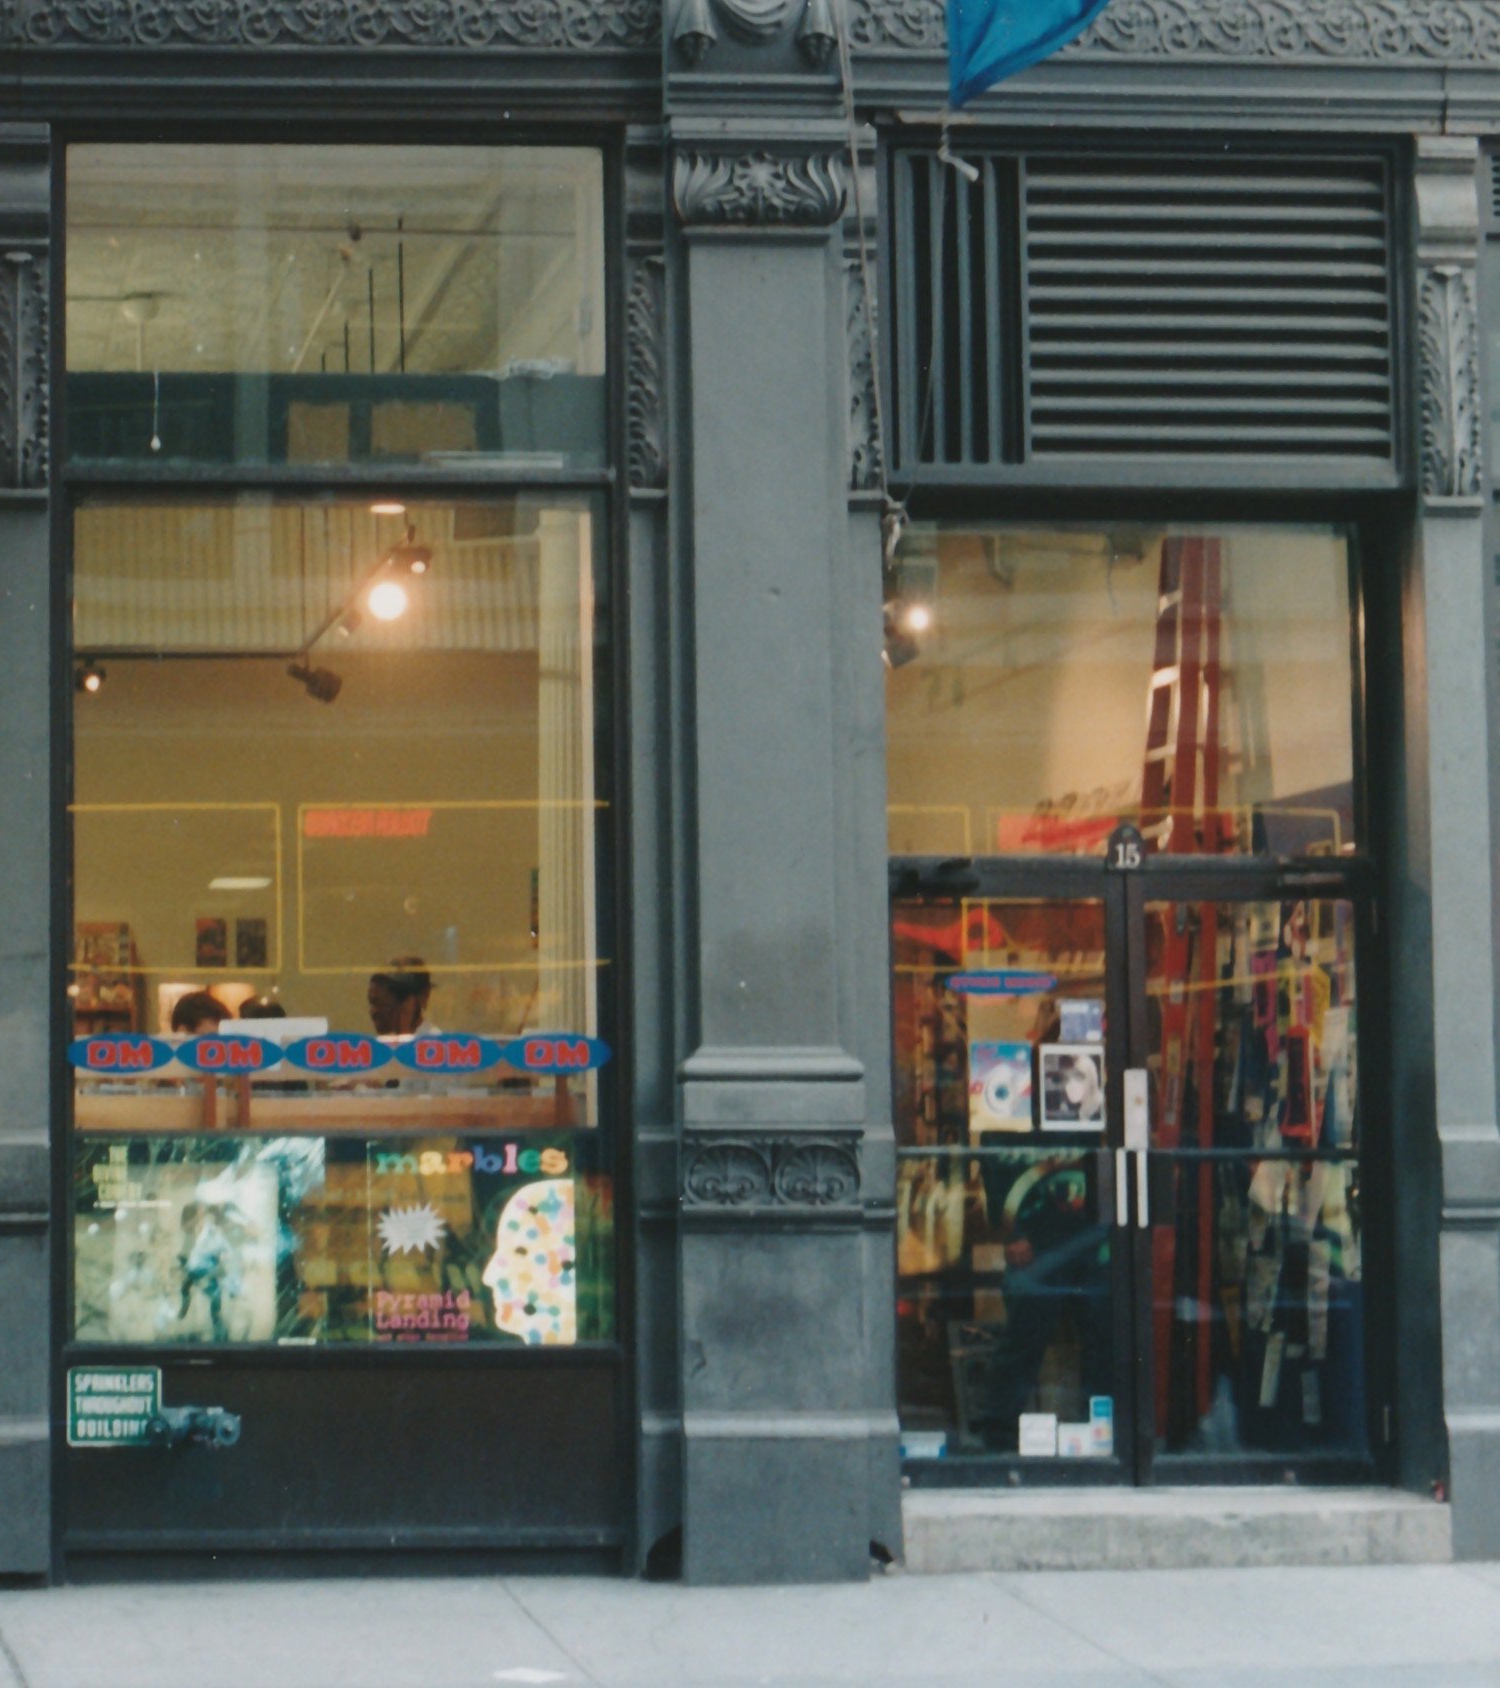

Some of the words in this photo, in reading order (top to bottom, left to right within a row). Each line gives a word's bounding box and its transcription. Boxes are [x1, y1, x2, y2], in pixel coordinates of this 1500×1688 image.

[1115, 843, 1141, 869] 15
[87, 1041, 153, 1067] OM
[197, 1040, 263, 1067] OM
[306, 1040, 373, 1067] OM
[415, 1040, 481, 1067] OM
[524, 1040, 590, 1067] OM
[375, 1143, 569, 1175] marbles
[377, 1290, 470, 1315] Pyramid
[376, 1310, 470, 1332] Landing
[74, 1374, 154, 1393] SPRINKLERS
